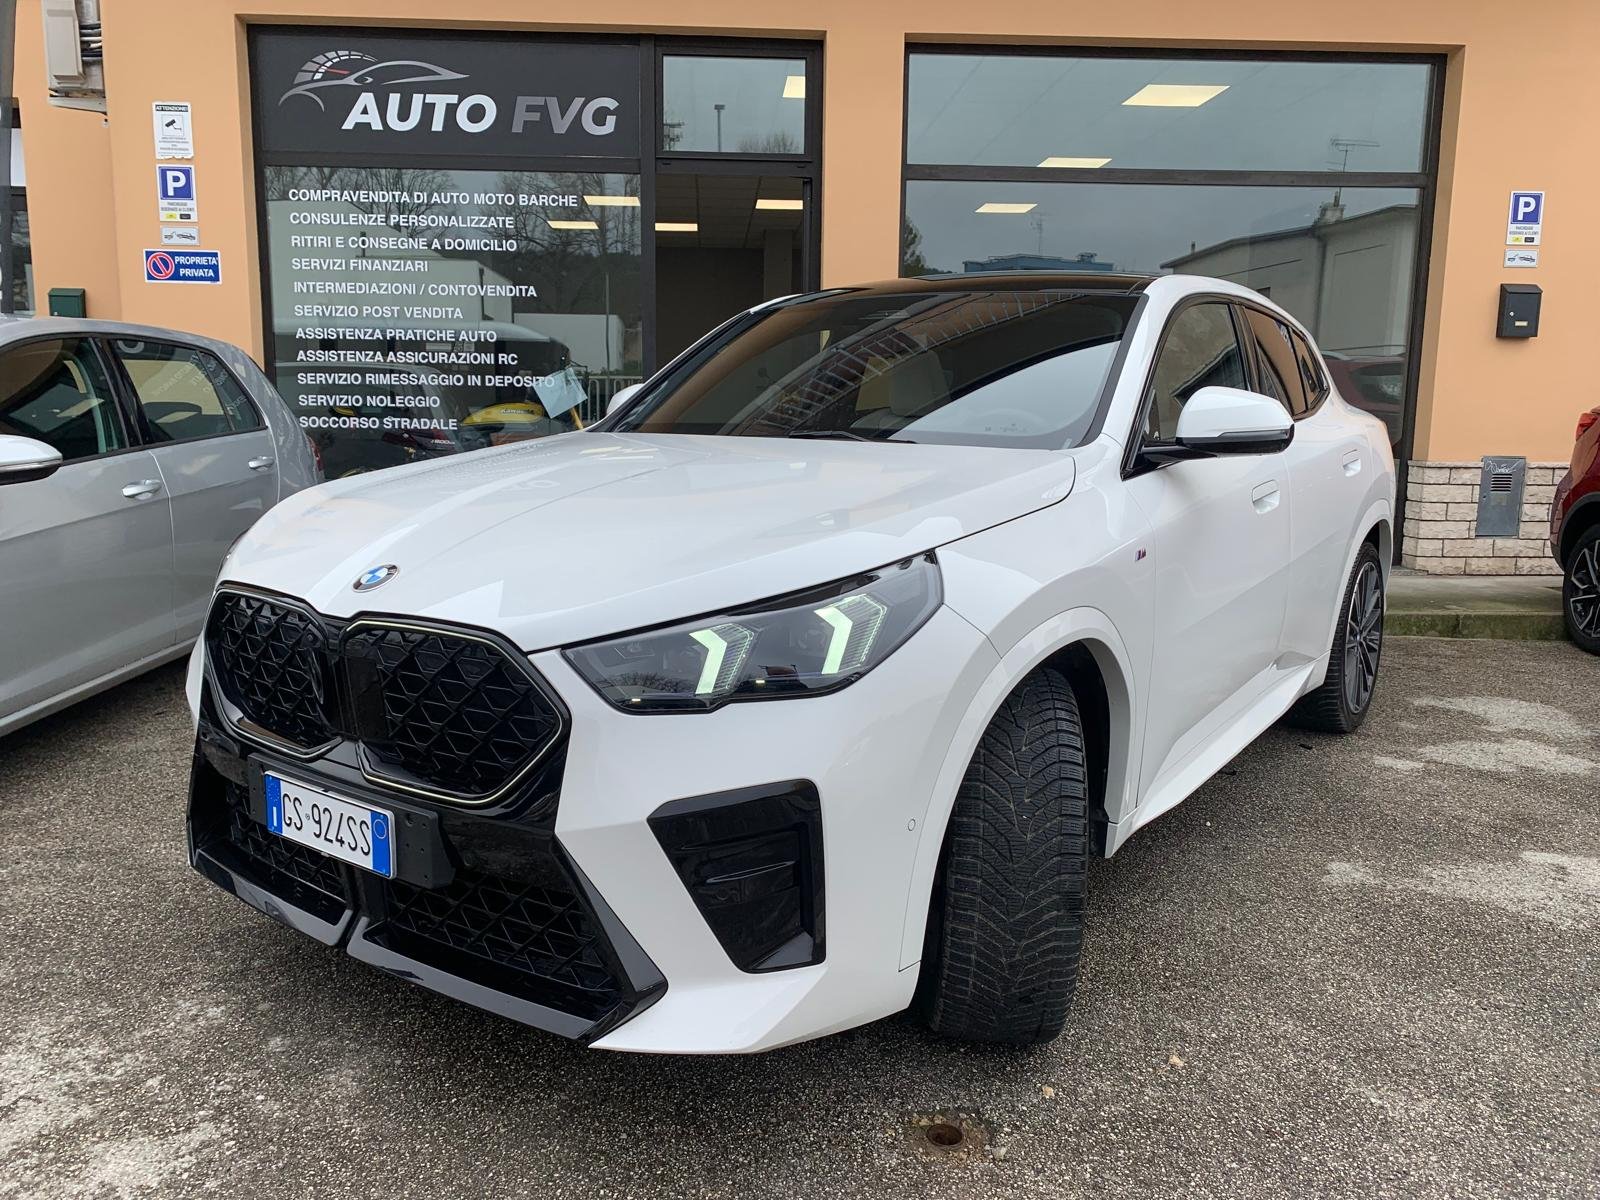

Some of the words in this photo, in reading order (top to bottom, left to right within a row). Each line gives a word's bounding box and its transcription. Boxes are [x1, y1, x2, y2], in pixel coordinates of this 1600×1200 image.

[341, 92, 497, 133] AUTO
[511, 96, 620, 136] FVG
[166, 170, 187, 196] P
[289, 189, 410, 203] COMPRAVENDITA
[413, 192, 427, 203] DI
[431, 192, 470, 204] AUTO
[474, 193, 515, 205] MOTO
[519, 194, 578, 207] BARCHE
[1517, 196, 1536, 220] P
[289, 212, 387, 226] CONSULENZE
[390, 214, 514, 228] PERSONALIZZATE
[291, 235, 331, 247] RITIRI
[335, 237, 344, 248] E
[348, 237, 428, 250] CONSEGNE
[431, 239, 441, 250] A
[444, 239, 517, 251] DOMICILIO
[180, 268, 215, 277] PRIVATA
[291, 258, 346, 270] SERVIZI
[349, 259, 428, 272] FINANZIARI
[294, 281, 416, 295] INTERMEDIAZIONI
[419, 284, 425, 295] /
[428, 284, 537, 297] CONTOVENDITA
[294, 305, 359, 317] SERVIZIO
[363, 306, 400, 318] POST
[404, 307, 463, 319] VENDITA
[295, 328, 383, 340] ASSISTENZA
[386, 329, 455, 341] PRATICHE
[459, 330, 497, 342] AUTO
[297, 350, 384, 362] ASSISTENZA
[387, 351, 495, 364] ASSICURAZIONI
[498, 353, 518, 365] RC
[297, 373, 361, 385] SERVIZIO
[365, 374, 464, 386] RIMESSAGGIO
[467, 375, 481, 386] IN
[485, 375, 555, 388] DEPOSITO
[298, 395, 363, 406] SERVIZIO
[366, 396, 440, 407] NOLEGGIO
[299, 416, 379, 428] SOCCORSO
[383, 417, 458, 430] STRADALE
